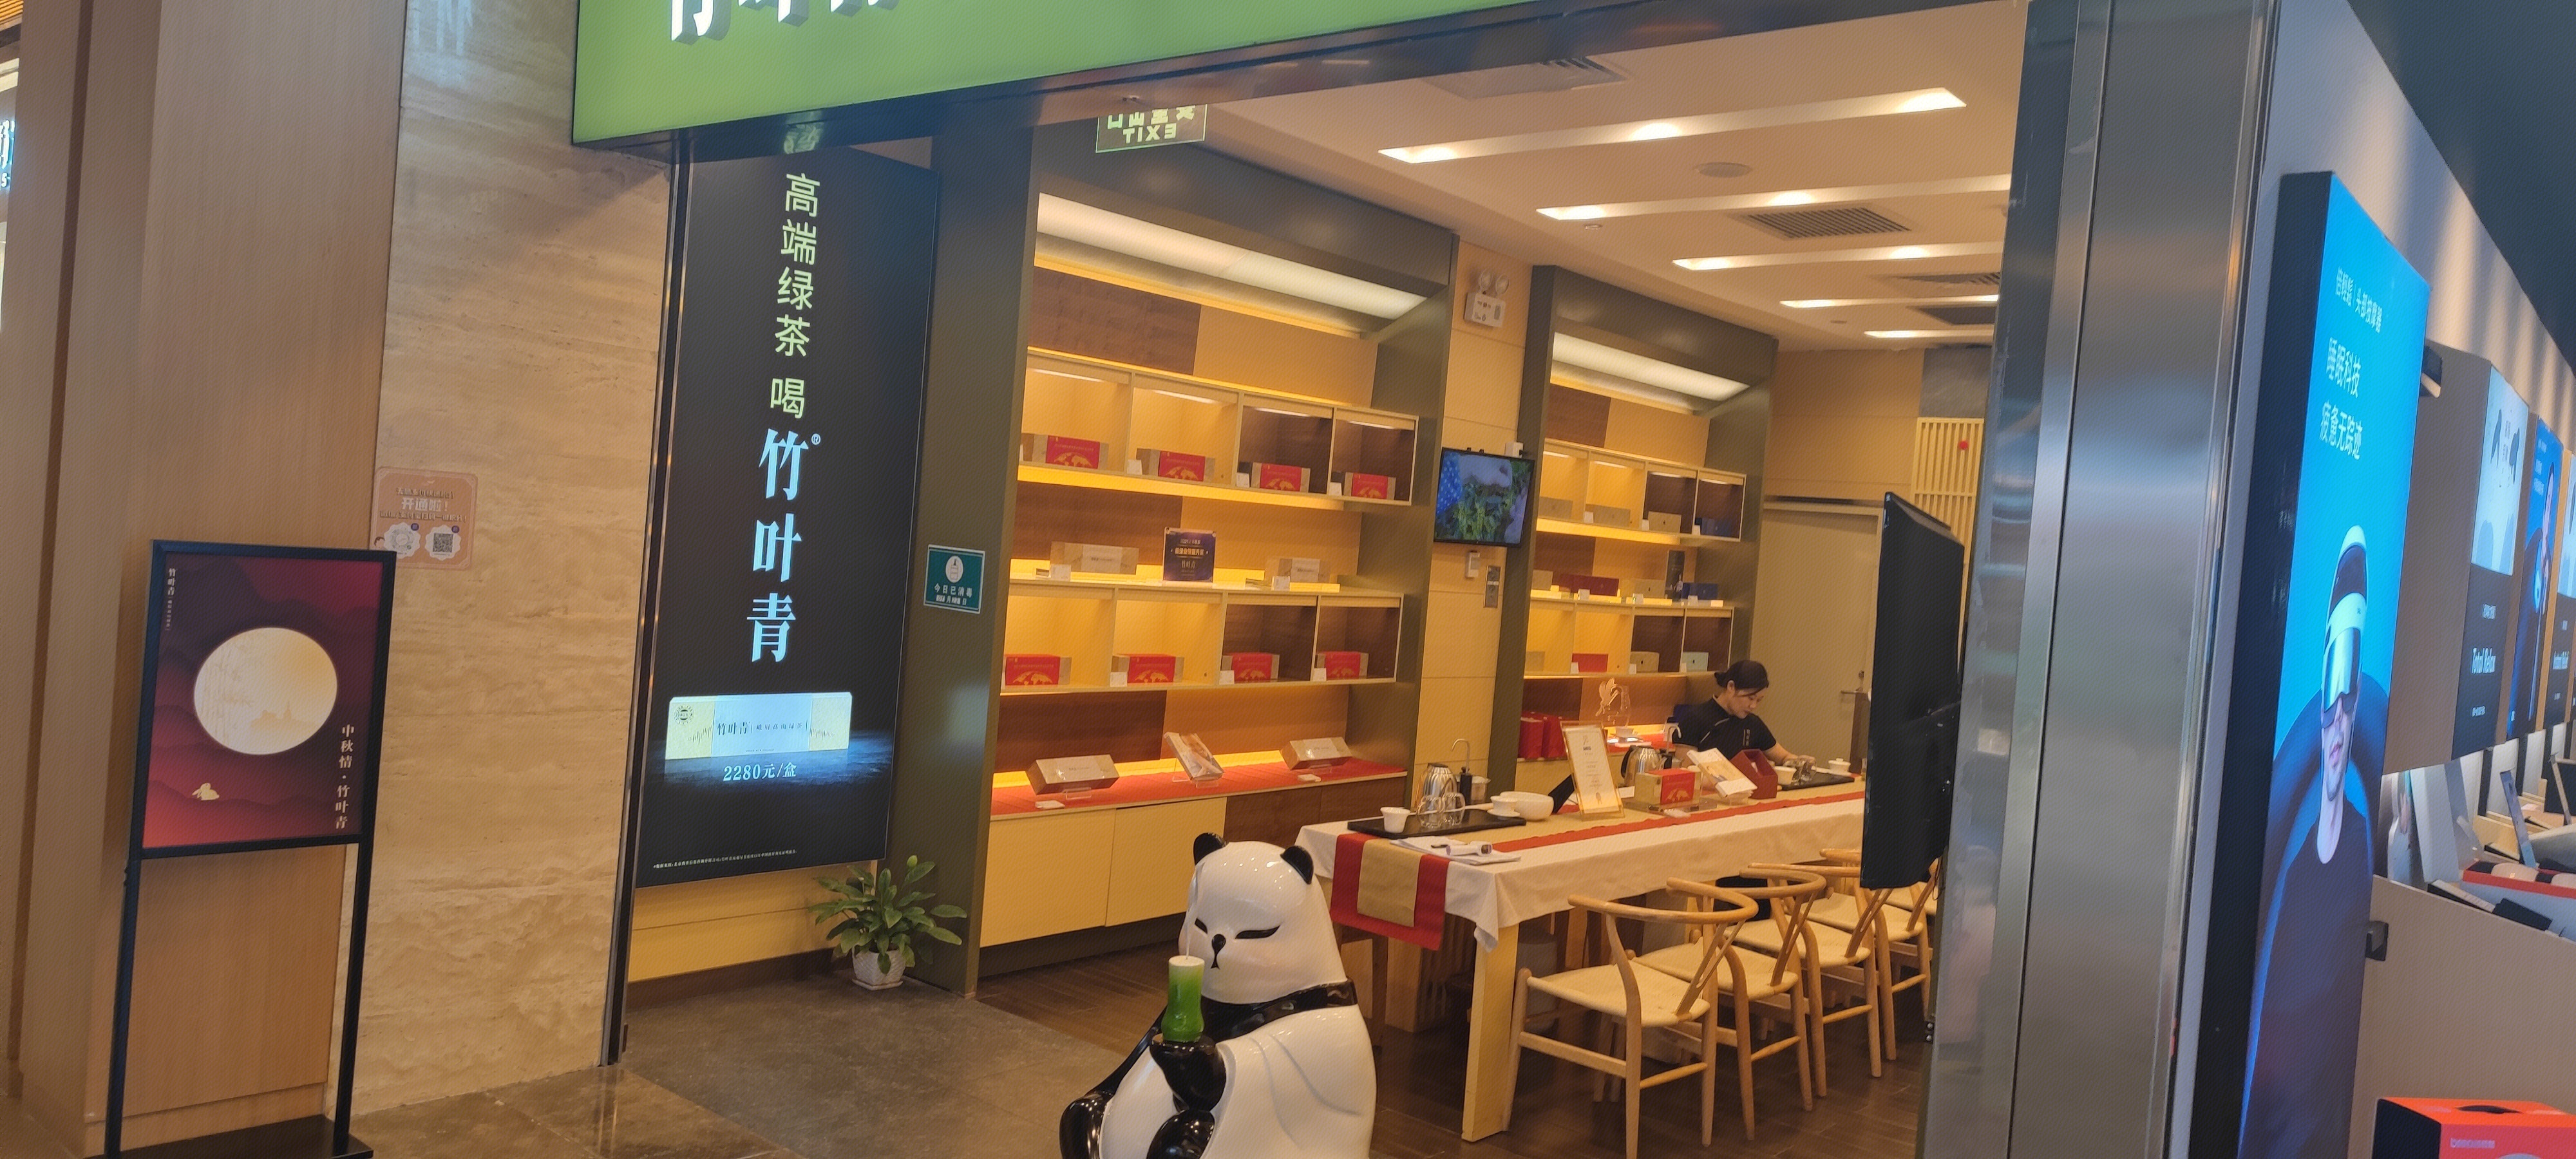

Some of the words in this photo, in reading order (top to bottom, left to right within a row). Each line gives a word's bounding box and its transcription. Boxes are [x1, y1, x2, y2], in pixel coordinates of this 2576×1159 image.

[775, 173, 820, 357] 高端绿茶
[2354, 287, 2383, 334] 头部按摩器
[2326, 336, 2362, 399] 睡眠科技
[770, 377, 804, 419] 喝
[2320, 399, 2363, 460] 疲惫无踪迹
[747, 429, 809, 663] 竹叶青
[934, 583, 972, 598] 今日已消毒
[717, 721, 751, 736] 竹叶青
[723, 762, 797, 782] 2280元/盒
